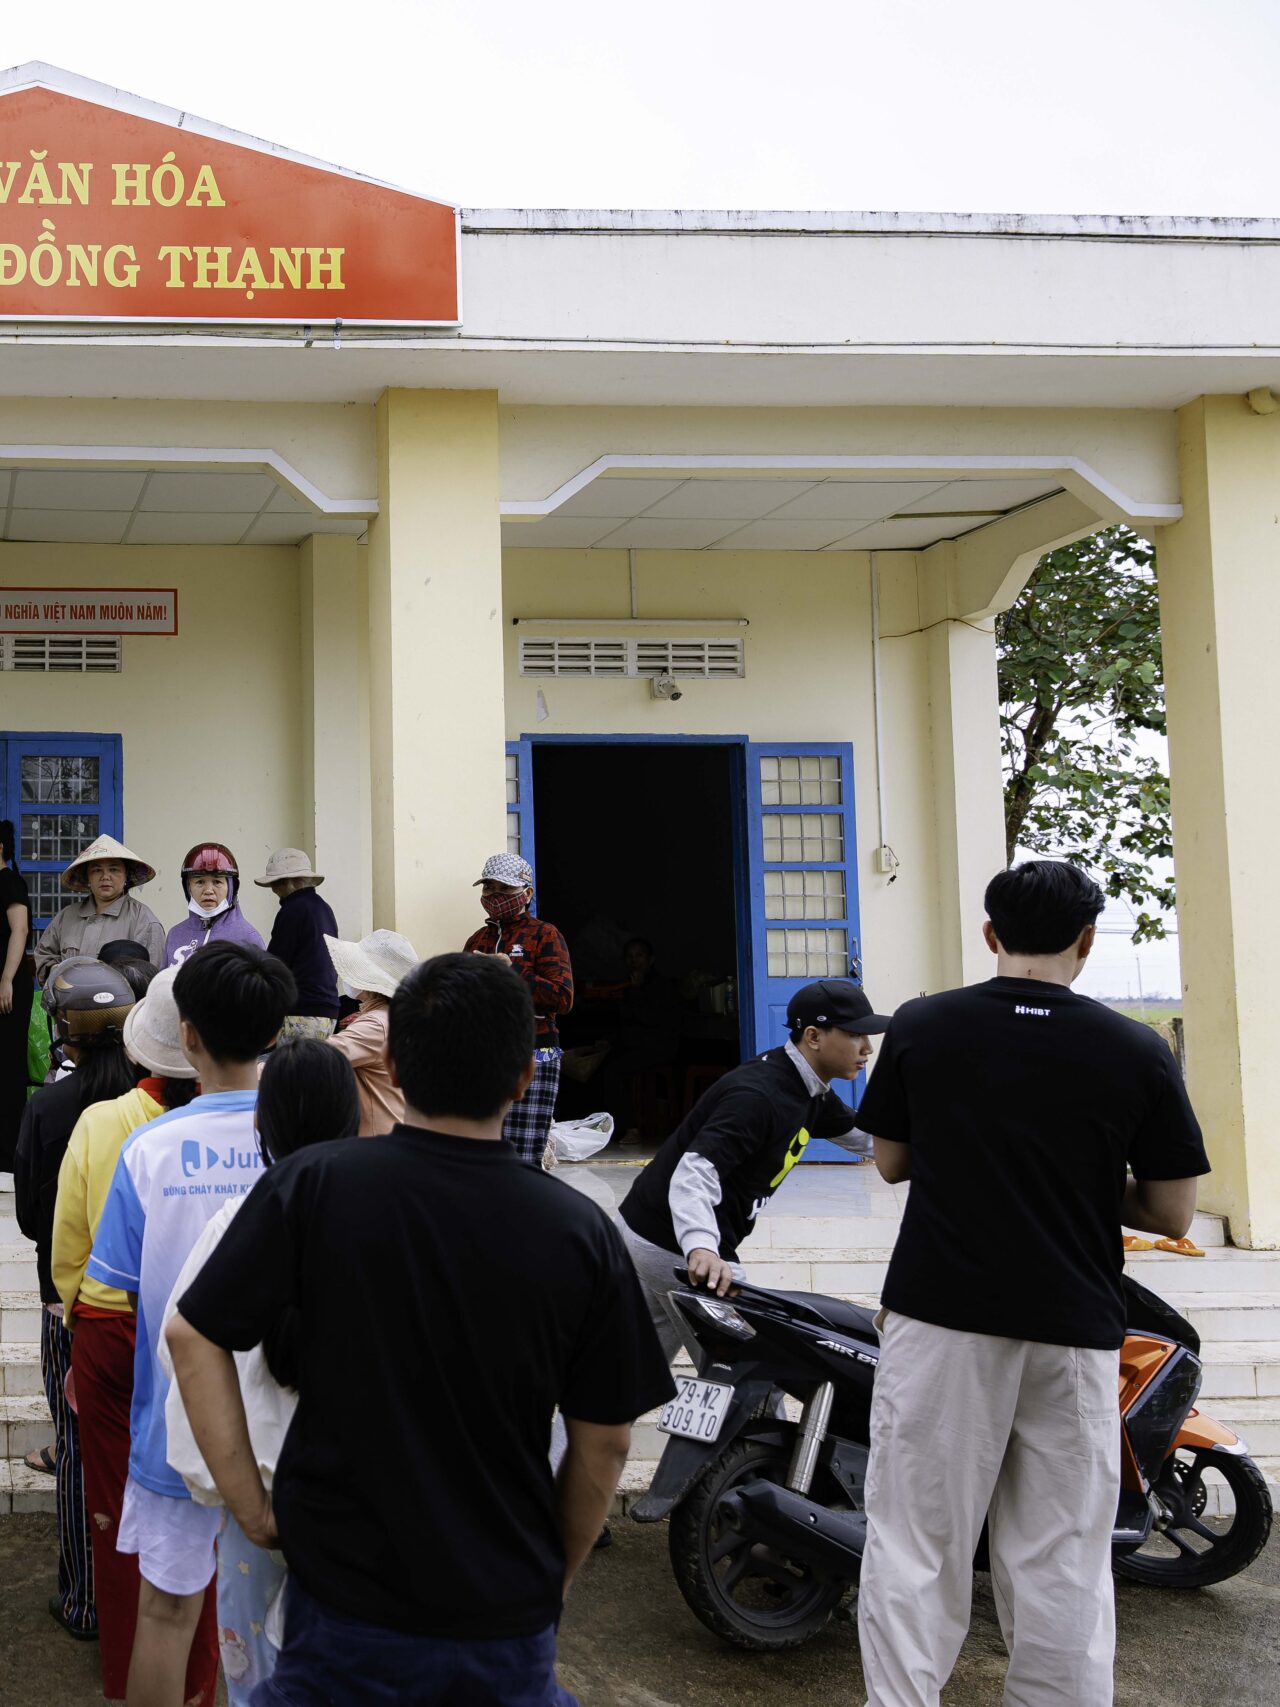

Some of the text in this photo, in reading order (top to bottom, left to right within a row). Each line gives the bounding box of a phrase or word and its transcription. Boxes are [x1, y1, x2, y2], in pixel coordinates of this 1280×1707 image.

[111, 151, 226, 208] HÓA
[158, 245, 346, 300] THẠNH
[4, 602, 40, 619] NGHĨA
[43, 602, 66, 623] VIỆT
[70, 605, 96, 620] NAM
[99, 602, 134, 620] MUÔN
[136, 602, 167, 620] NĂM!
[662, 1404, 718, 1437] 309.10
